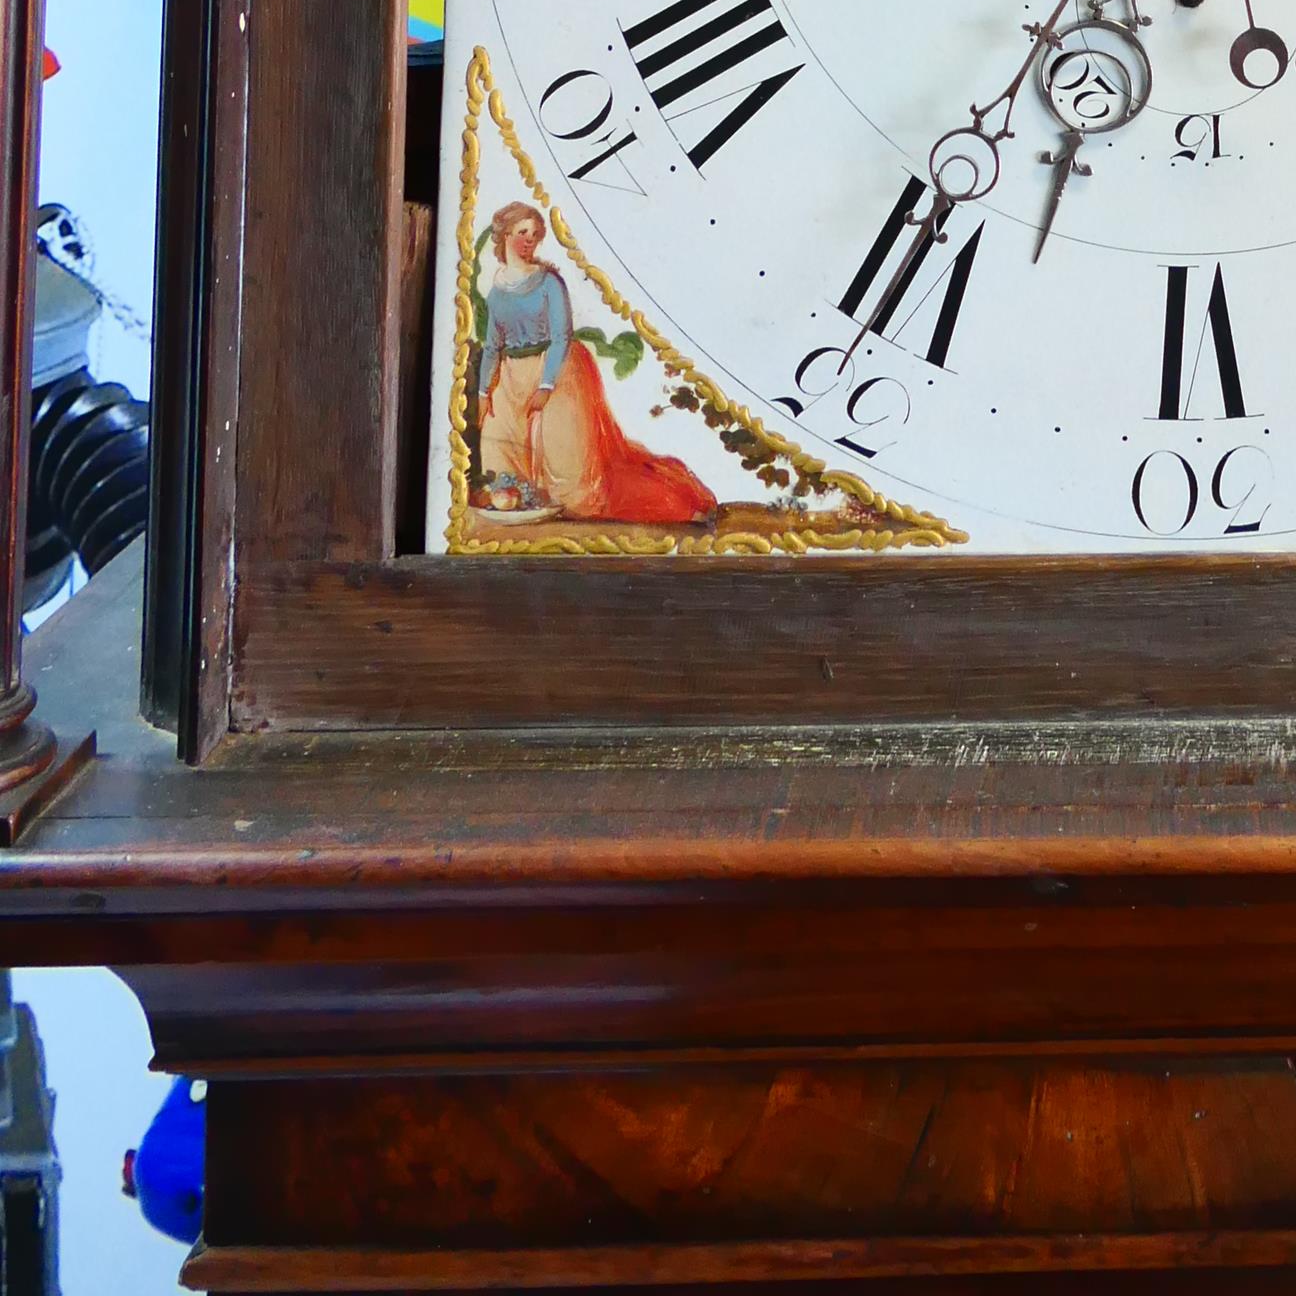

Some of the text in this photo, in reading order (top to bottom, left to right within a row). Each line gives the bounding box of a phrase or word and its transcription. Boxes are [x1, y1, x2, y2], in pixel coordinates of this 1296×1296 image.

[538, 68, 648, 197] 40
[1049, 52, 1118, 119] 20
[1171, 114, 1232, 161] 15
[824, 165, 985, 376] VII
[1143, 261, 1265, 421] VI
[770, 345, 911, 460] 35
[1131, 444, 1274, 536] 30
